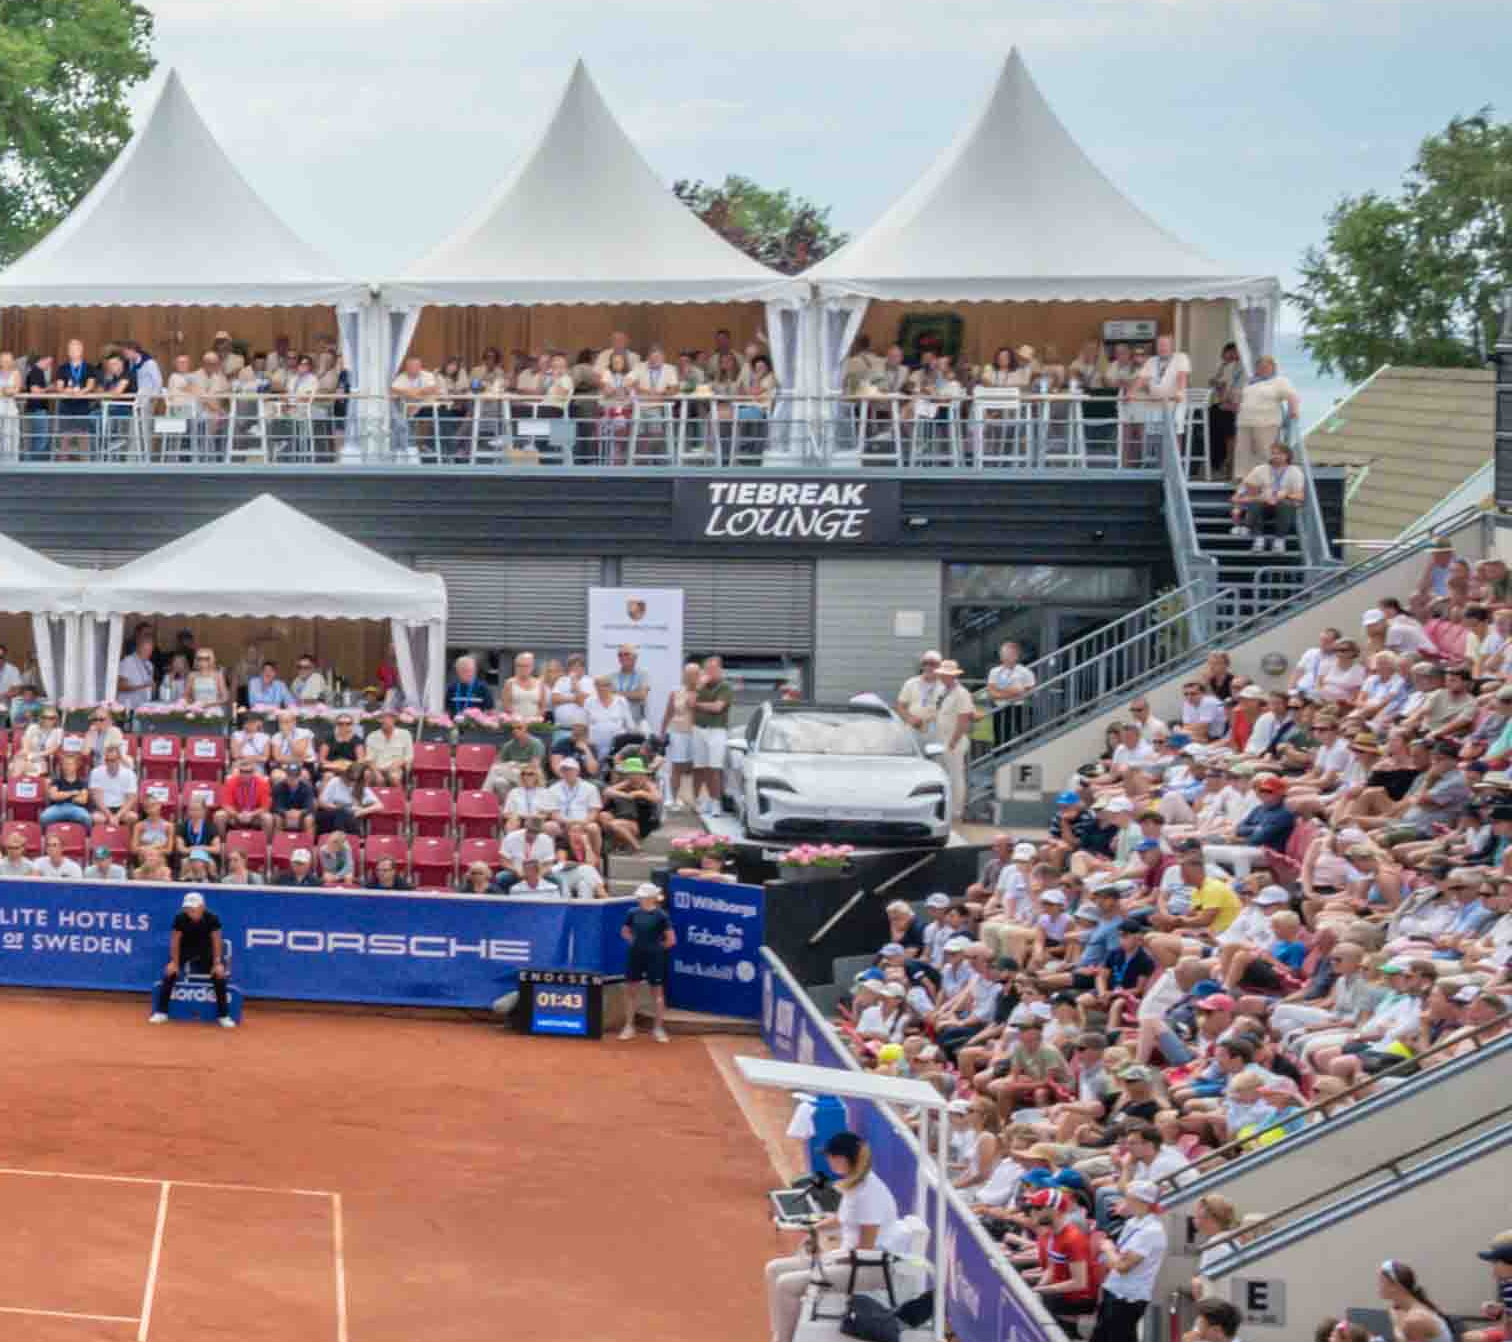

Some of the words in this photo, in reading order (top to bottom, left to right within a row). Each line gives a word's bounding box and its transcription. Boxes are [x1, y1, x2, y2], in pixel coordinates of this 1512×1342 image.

[708, 483, 867, 505] TIEBREAK
[705, 507, 870, 541] LOUNGE
[1019, 765, 1033, 782] F
[58, 908, 150, 932] HOTELS
[32, 933, 133, 955] SWEDEN
[245, 927, 532, 962] PORSCHE
[687, 925, 743, 953] Fabege
[537, 992, 583, 1009] 01:43
[1247, 1281, 1268, 1310] E
